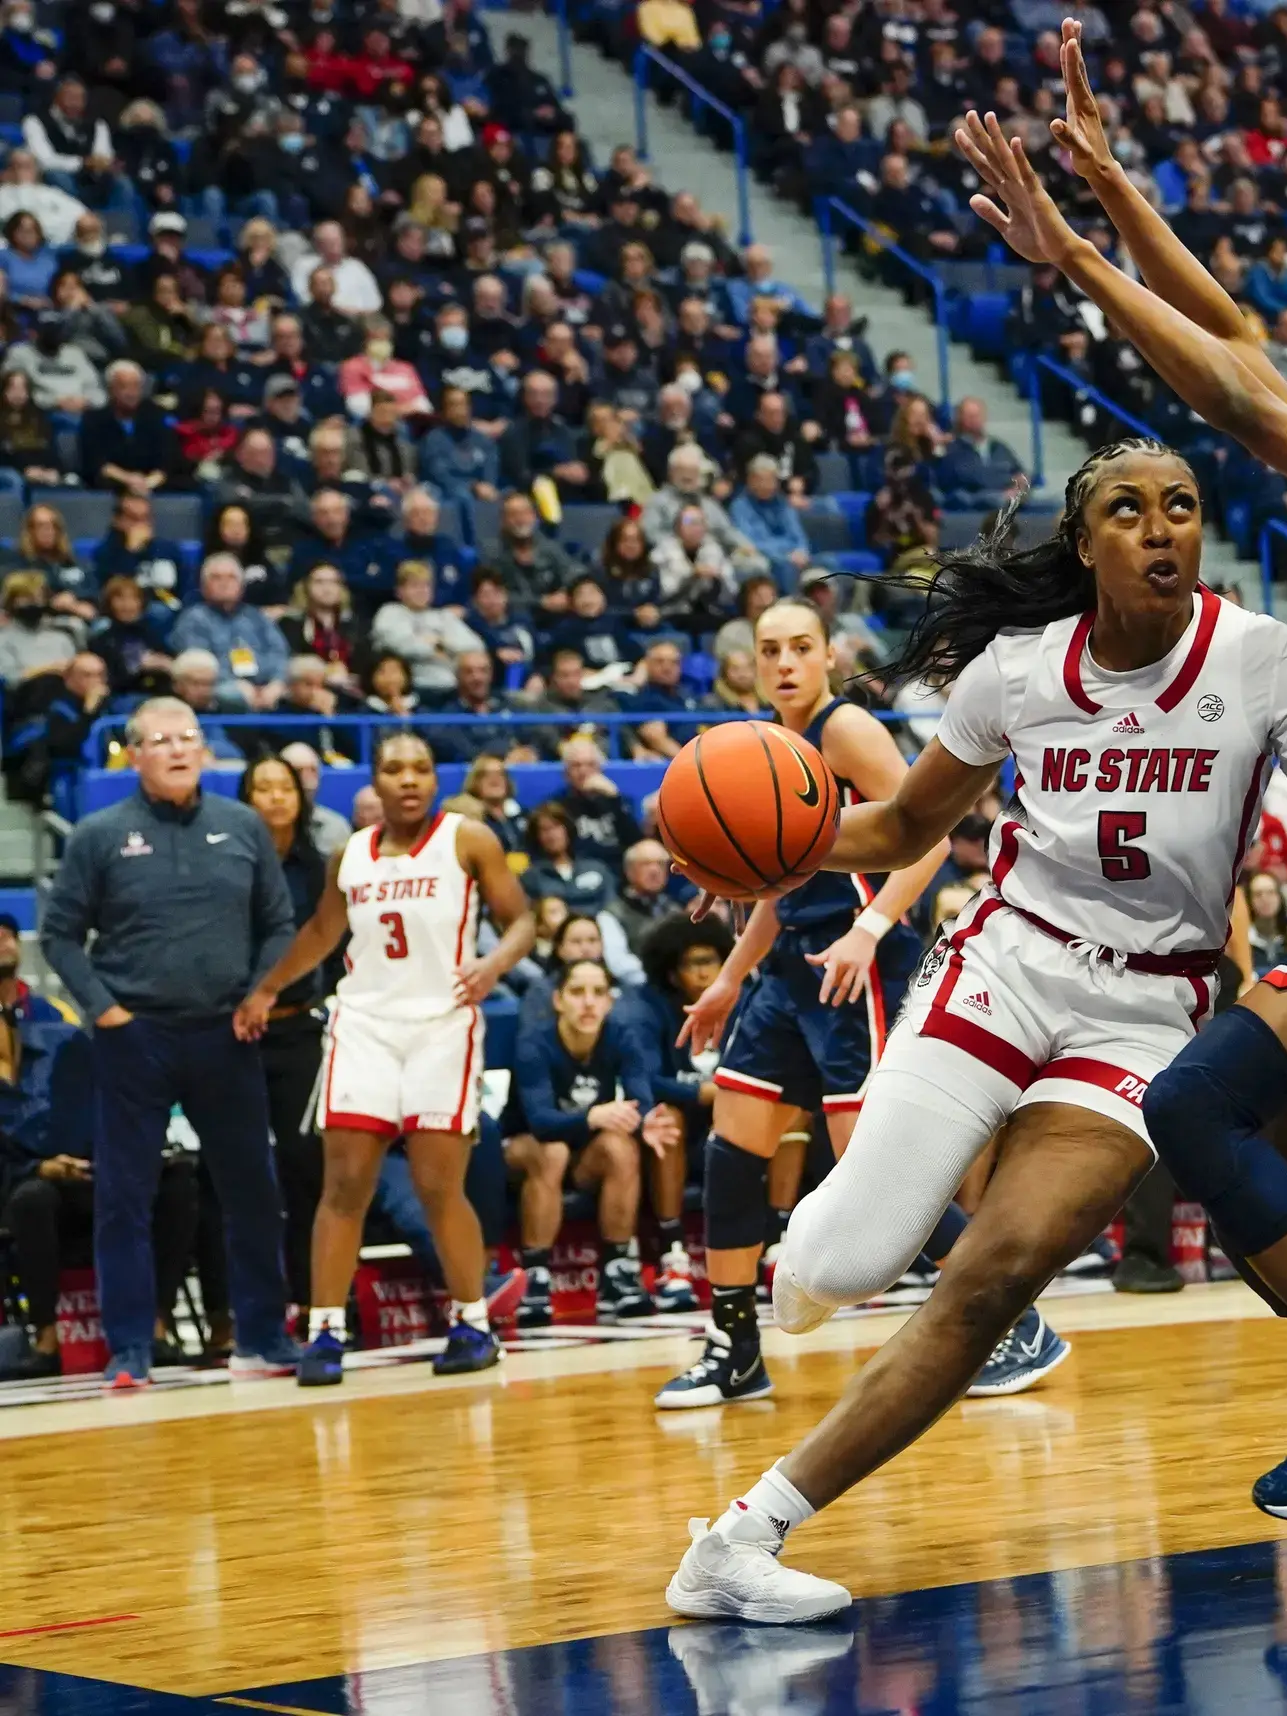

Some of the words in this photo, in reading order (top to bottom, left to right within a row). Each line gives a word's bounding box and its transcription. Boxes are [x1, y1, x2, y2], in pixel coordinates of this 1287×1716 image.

[1200, 703, 1224, 711] ACC
[1112, 724, 1145, 734] adidas
[1041, 747, 1092, 793] NC
[1094, 747, 1221, 793] STATE
[1097, 810, 1152, 882] 5
[349, 883, 372, 907] NC
[376, 876, 440, 903] STATE
[379, 912, 409, 960] 3
[962, 996, 993, 1017] adidas
[1114, 1074, 1149, 1103] PA
